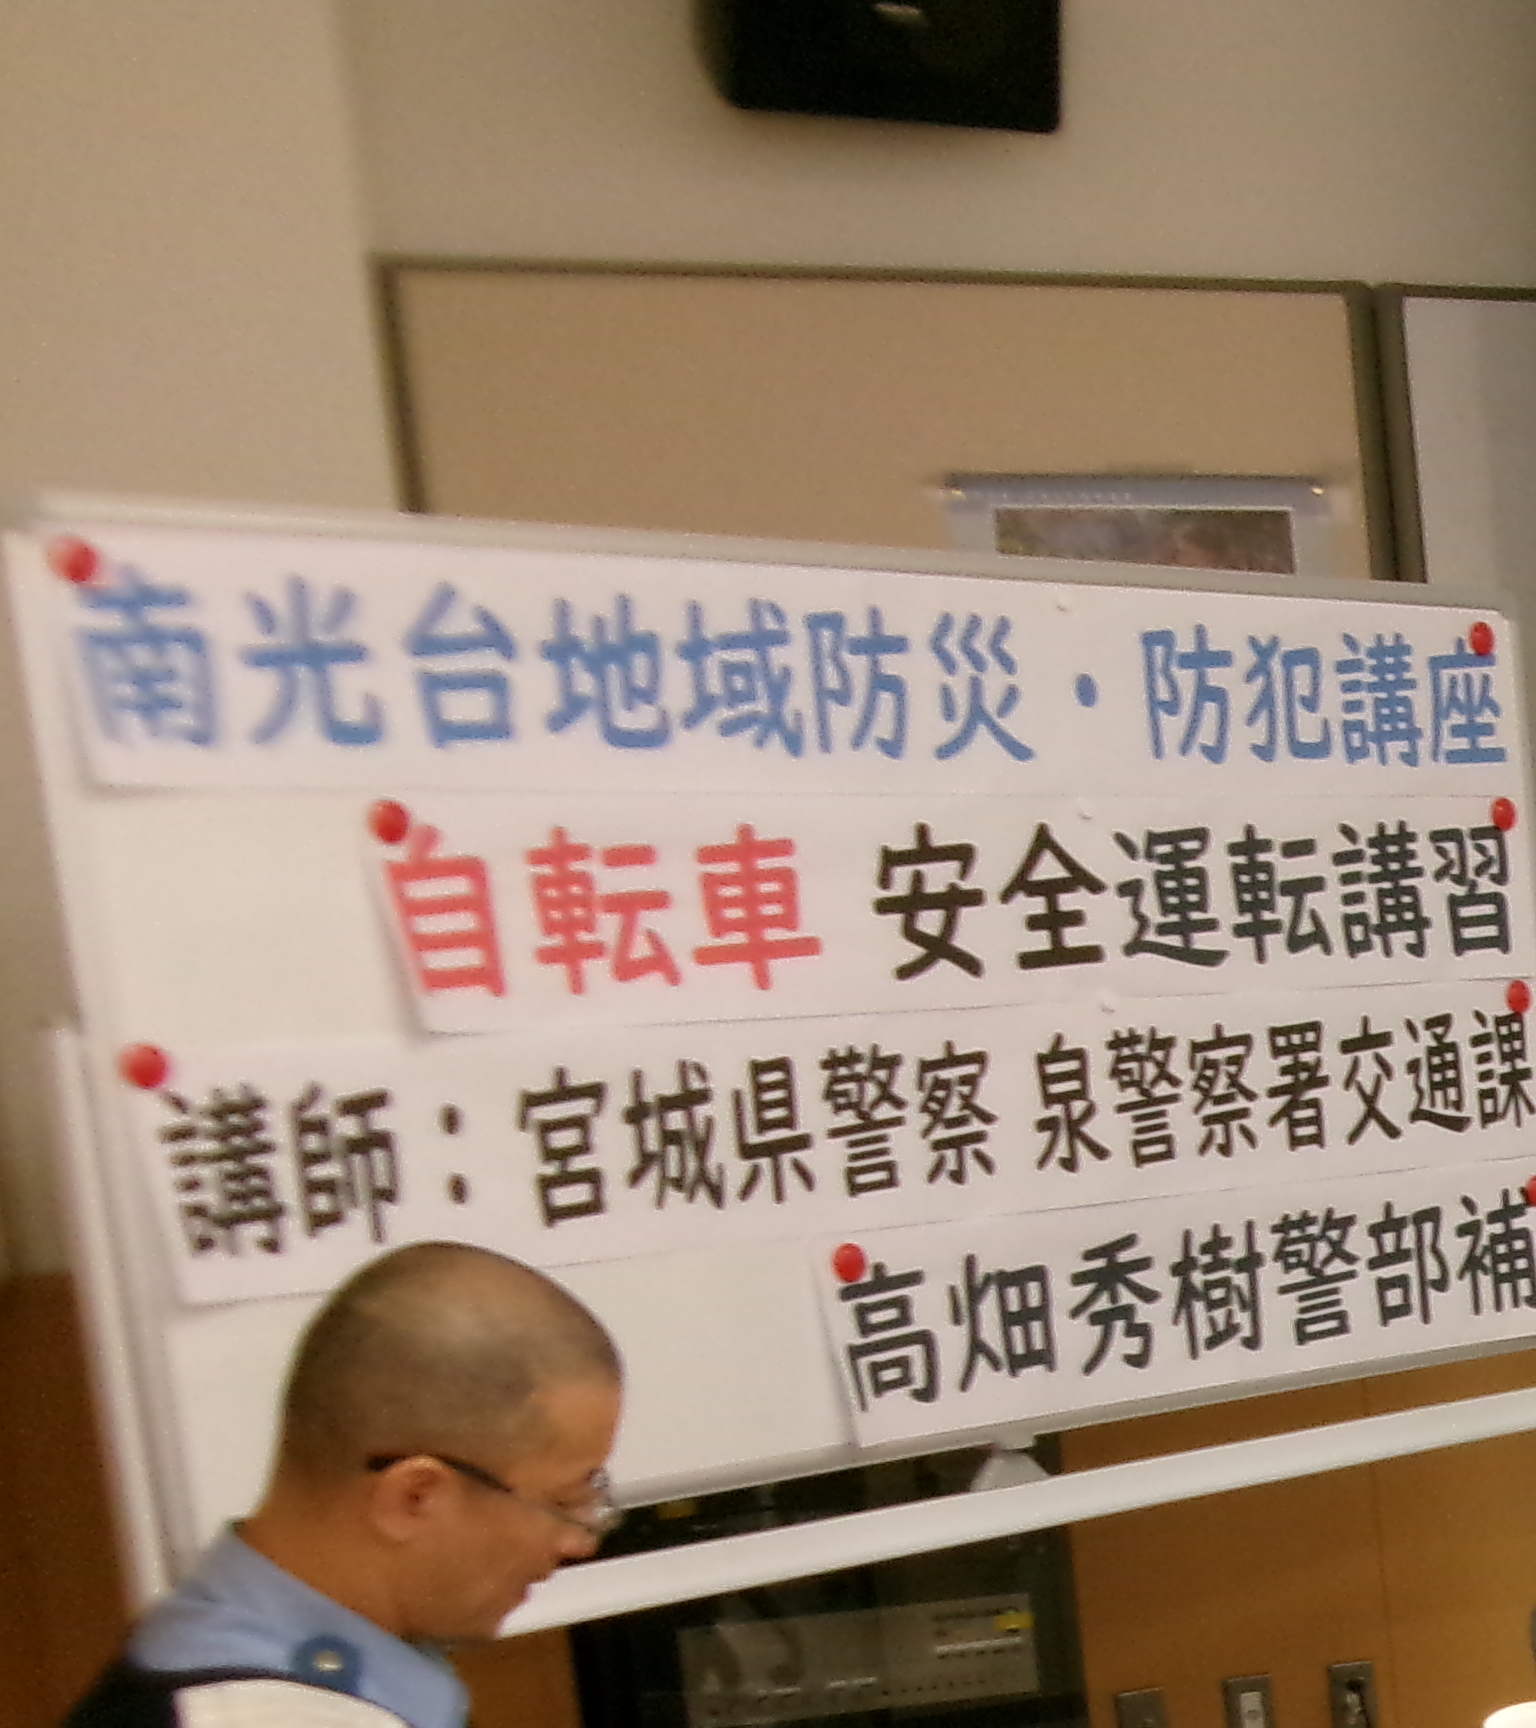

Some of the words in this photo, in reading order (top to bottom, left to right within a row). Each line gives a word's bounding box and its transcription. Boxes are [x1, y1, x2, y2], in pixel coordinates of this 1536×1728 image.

[78, 568, 1507, 767] 南光台地域防災・防犯講座
[385, 823, 823, 998] 自転車
[873, 822, 1513, 981] 安全運転講習
